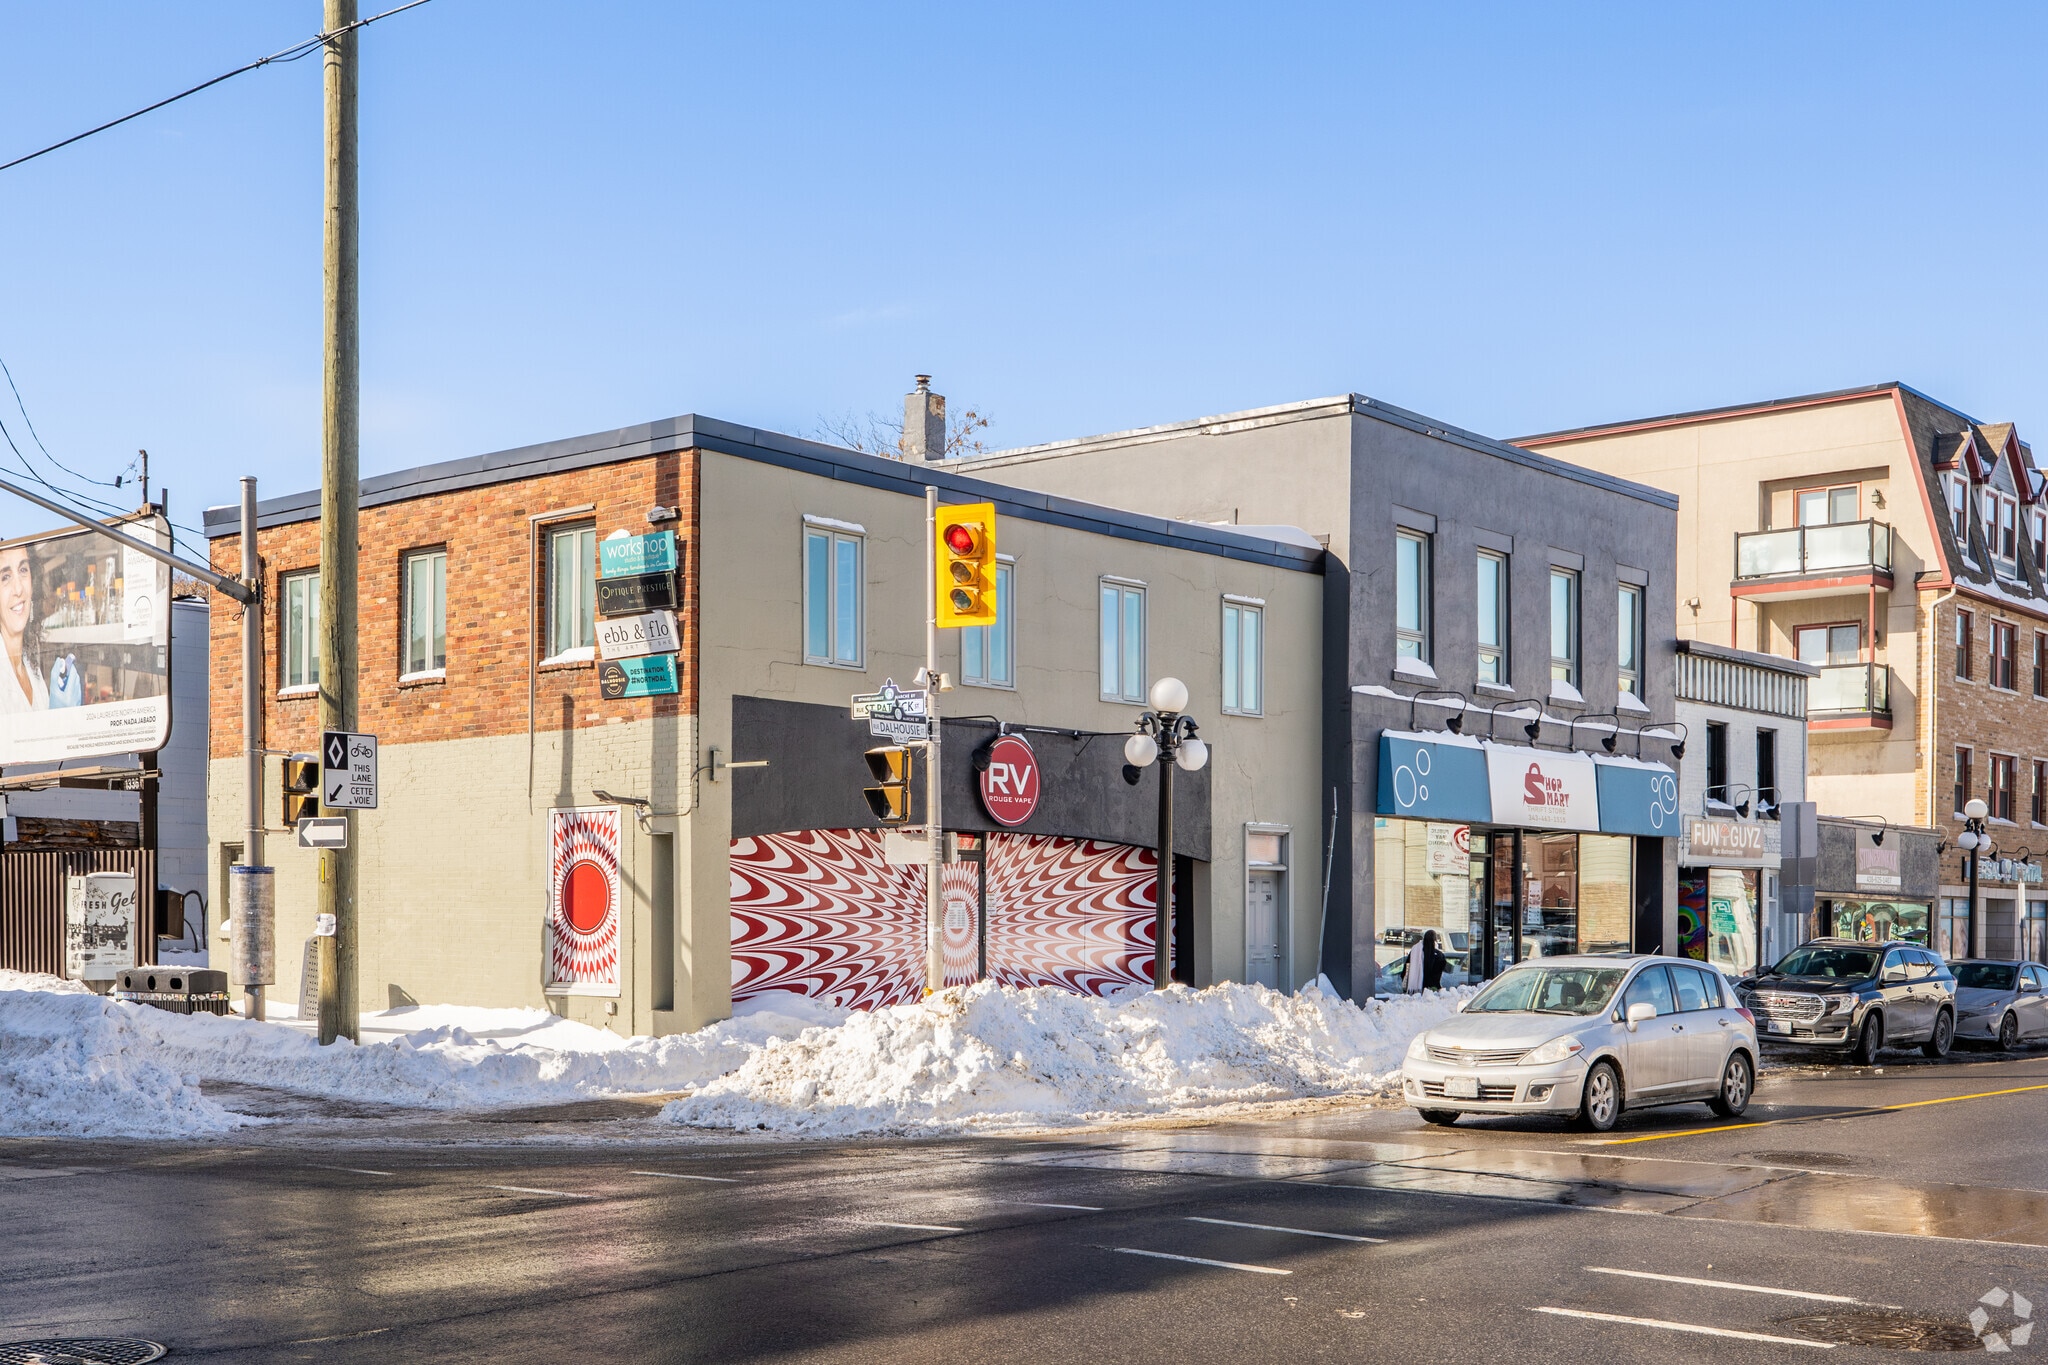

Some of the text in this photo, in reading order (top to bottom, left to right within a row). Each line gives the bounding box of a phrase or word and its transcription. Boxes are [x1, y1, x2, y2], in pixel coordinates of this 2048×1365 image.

[606, 536, 668, 559] workshop
[604, 620, 669, 644] ebb & flo
[607, 645, 620, 653] THE
[658, 638, 672, 646] SHE
[630, 666, 665, 676] DESTINATION
[631, 675, 667, 684] #NORTHDAL
[97, 711, 119, 720] LAUREATE
[119, 708, 136, 717] NORTH
[137, 706, 156, 714] AMERICA
[138, 716, 157, 724] JABADO
[880, 722, 921, 736] DALHOUSIE
[354, 764, 370, 772] THIS
[351, 774, 372, 782] LANE
[988, 762, 1032, 795] RV
[350, 786, 374, 796] CETTE
[354, 796, 370, 805] VOIE
[989, 795, 1013, 803] ROUGE
[1527, 805, 1566, 815] THRIFT STORE
[1694, 823, 1761, 848] FUN GUYZ
